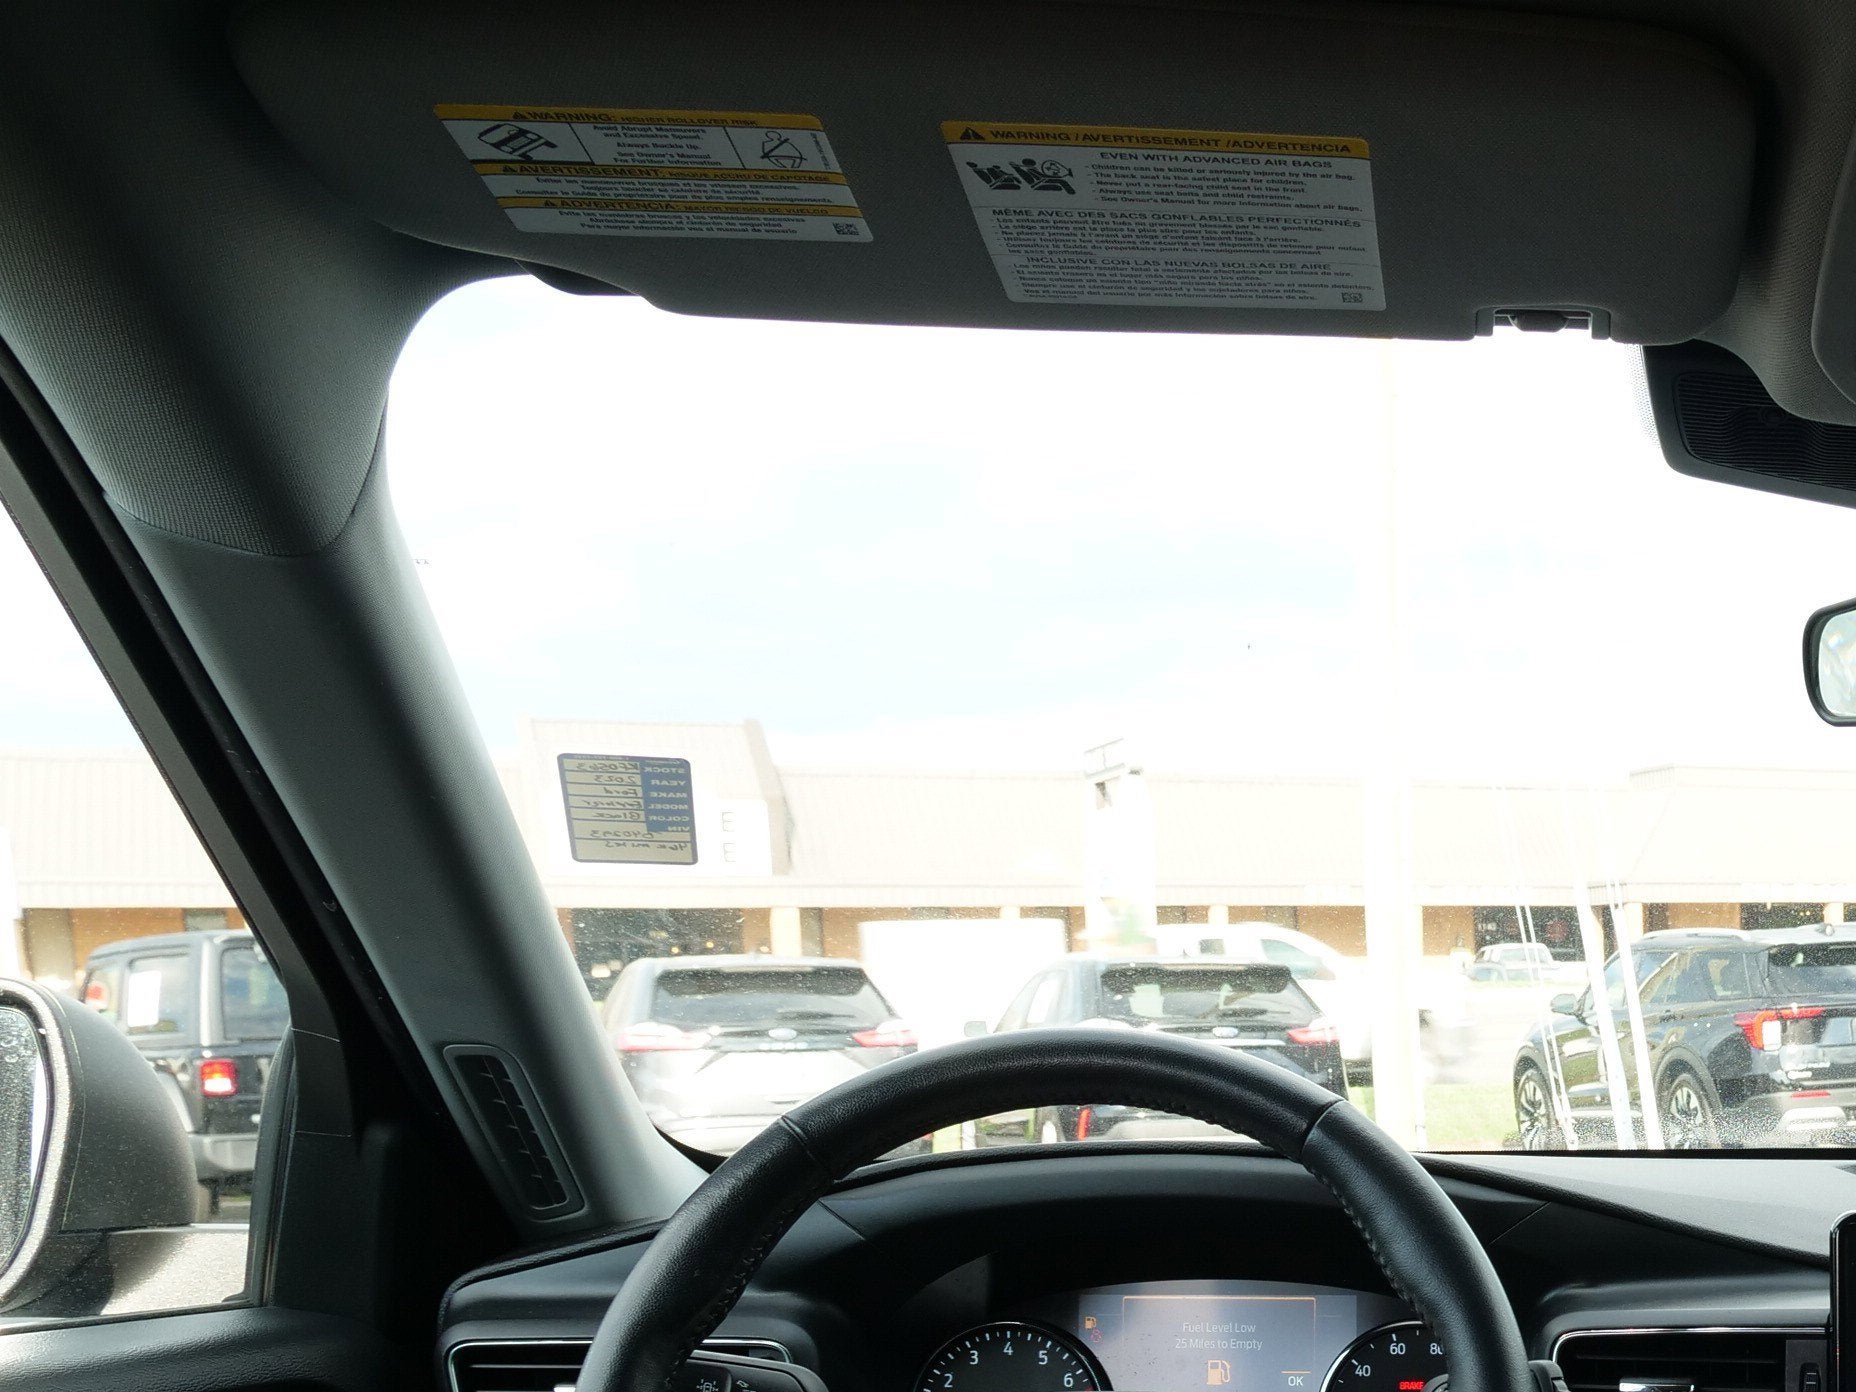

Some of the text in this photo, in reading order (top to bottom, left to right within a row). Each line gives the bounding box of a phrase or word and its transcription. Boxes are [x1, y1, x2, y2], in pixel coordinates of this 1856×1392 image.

[990, 129, 1070, 141] WARNING
[1100, 152, 1332, 168] EVEN WITH ADVANCED AIR BAGS
[1037, 209, 1073, 218] AVEC
[1077, 210, 1105, 219] DES
[1109, 211, 1146, 220] SACS
[1151, 212, 1244, 223] GONFLABLES
[1183, 1322, 1256, 1333] Fuel Level Low
[1003, 1341, 1013, 1355] 4
[1189, 1338, 1215, 1349] Miles
[1217, 1339, 1227, 1349] to
[1230, 1338, 1263, 1351] Empty
[1389, 1343, 1406, 1355] 60
[969, 1350, 979, 1365] 3
[1038, 1350, 1048, 1365] 5
[1354, 1364, 1371, 1377] 40
[944, 1373, 953, 1388] 2
[1063, 1373, 1074, 1388] 6
[1287, 1376, 1304, 1387] OK
[1399, 1381, 1425, 1391] BRAKE
